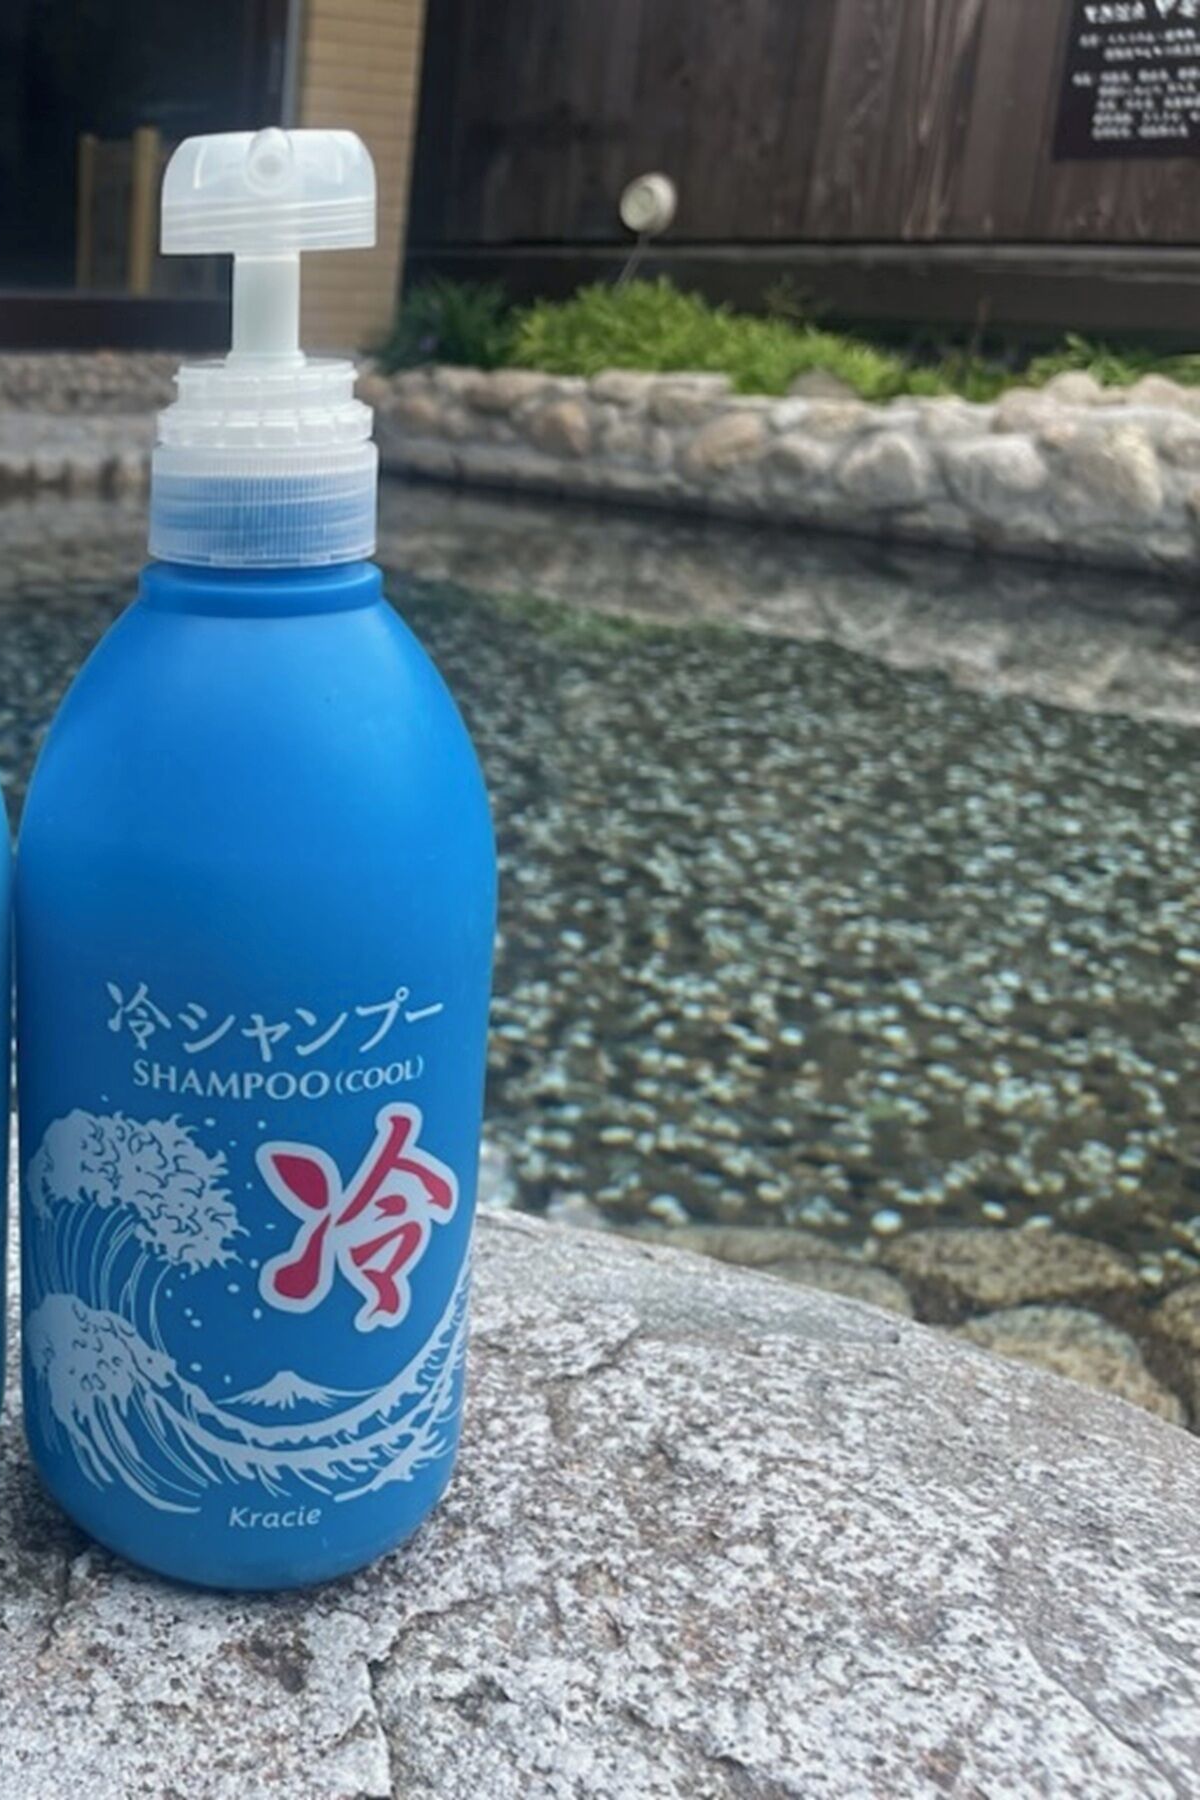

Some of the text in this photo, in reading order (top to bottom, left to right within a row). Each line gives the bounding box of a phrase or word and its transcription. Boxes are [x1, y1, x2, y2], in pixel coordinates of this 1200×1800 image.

[105, 985, 445, 1064] 冷シャンプー
[264, 1109, 455, 1325] 冷
[227, 1504, 323, 1529] Kracie
